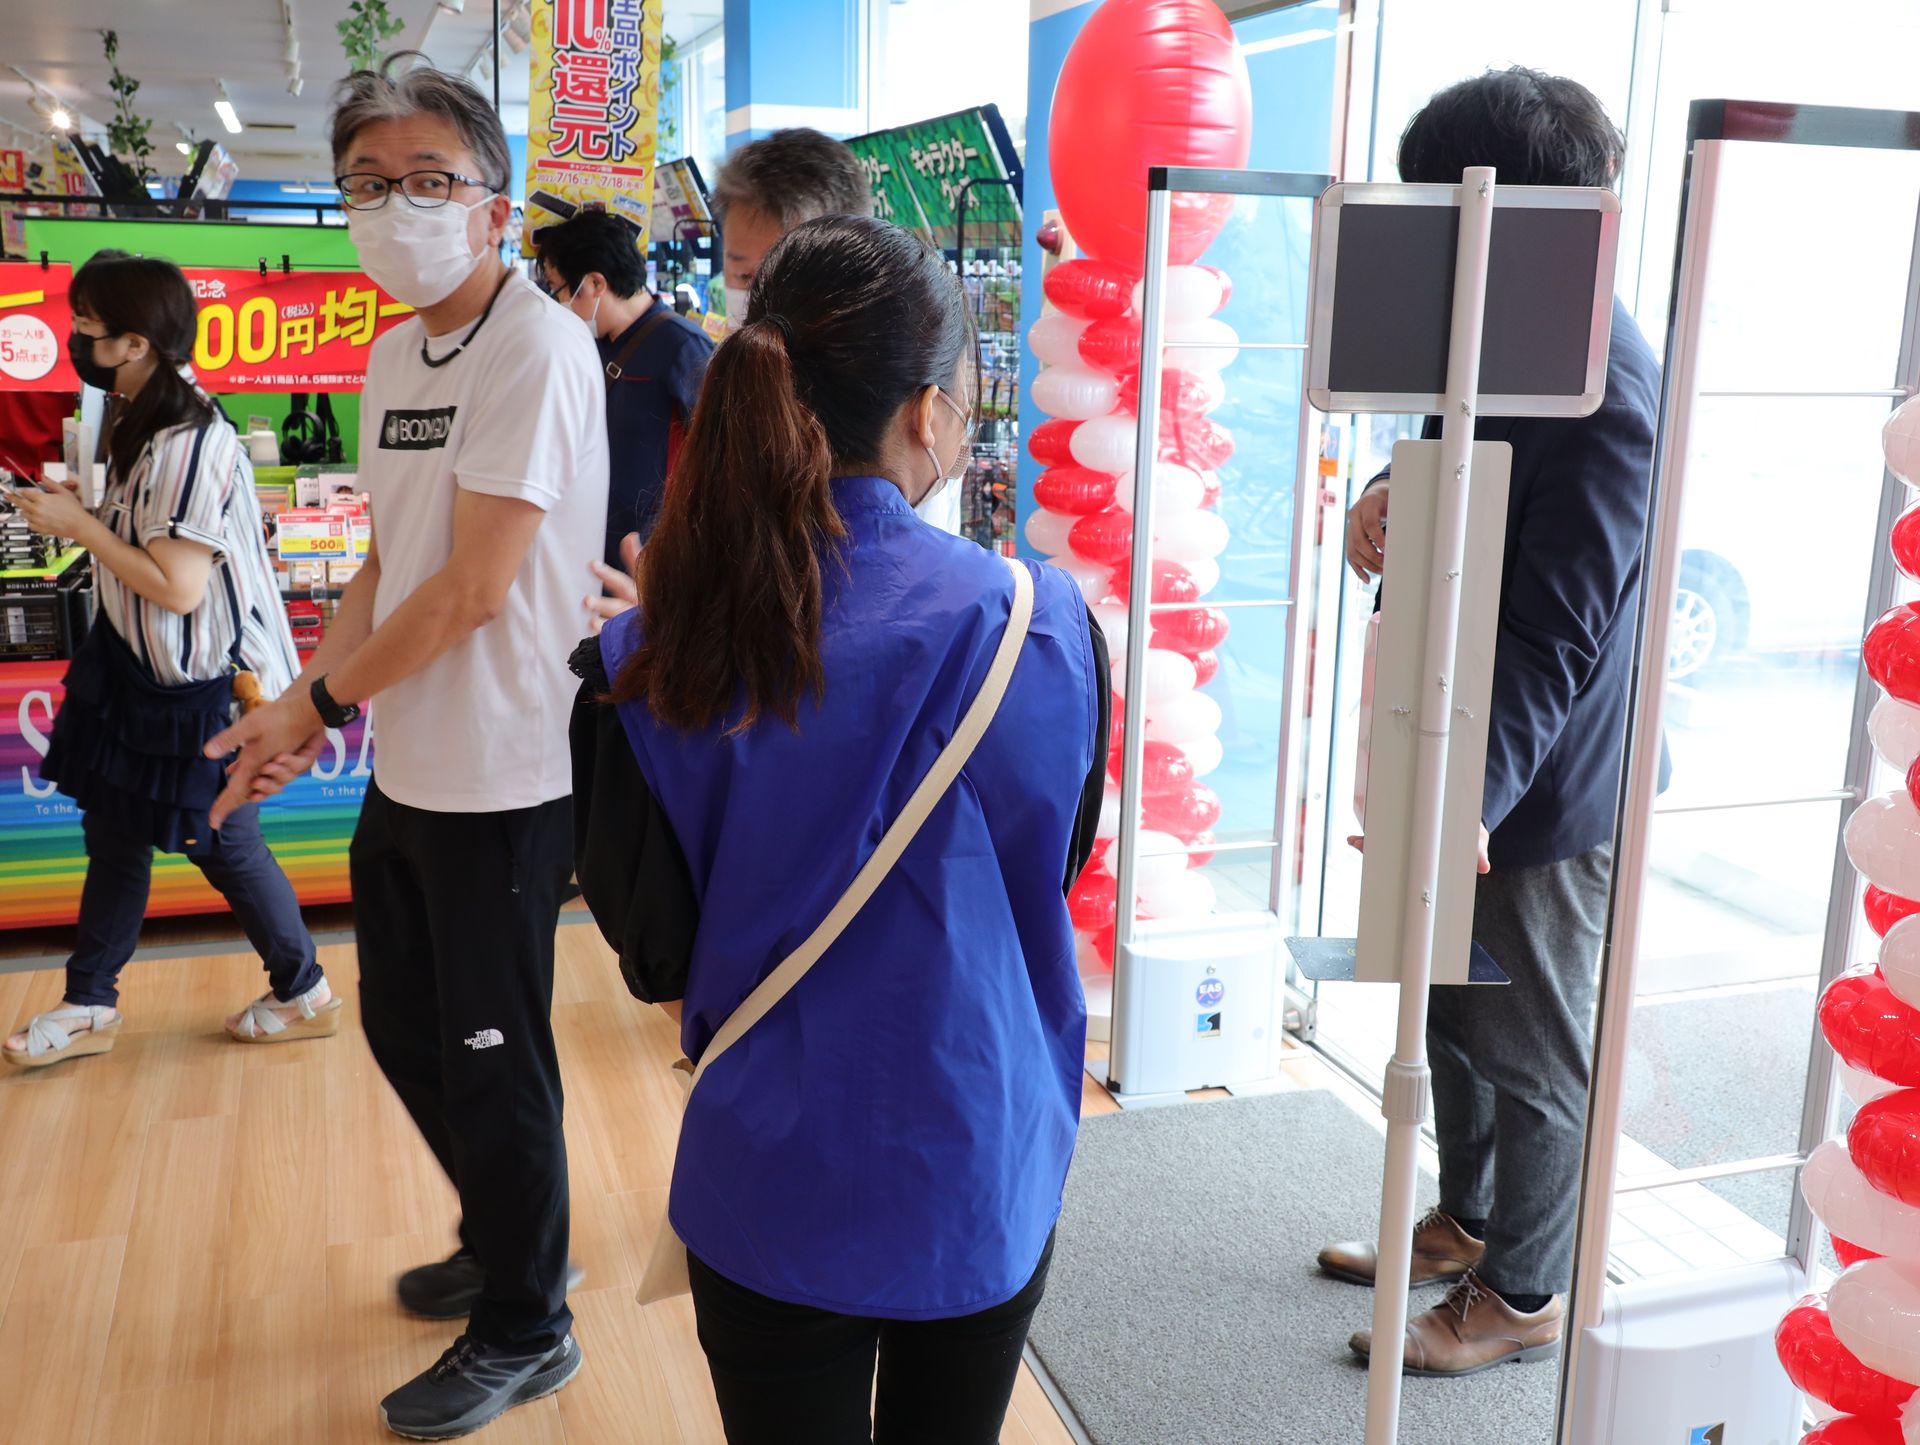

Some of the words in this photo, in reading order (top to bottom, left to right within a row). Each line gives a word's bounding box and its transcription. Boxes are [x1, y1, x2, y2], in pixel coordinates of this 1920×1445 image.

[321, 787, 334, 797] To
[337, 786, 356, 796] the
[35, 804, 49, 815] To
[54, 803, 73, 814] the
[1199, 983, 1222, 994] EAS
